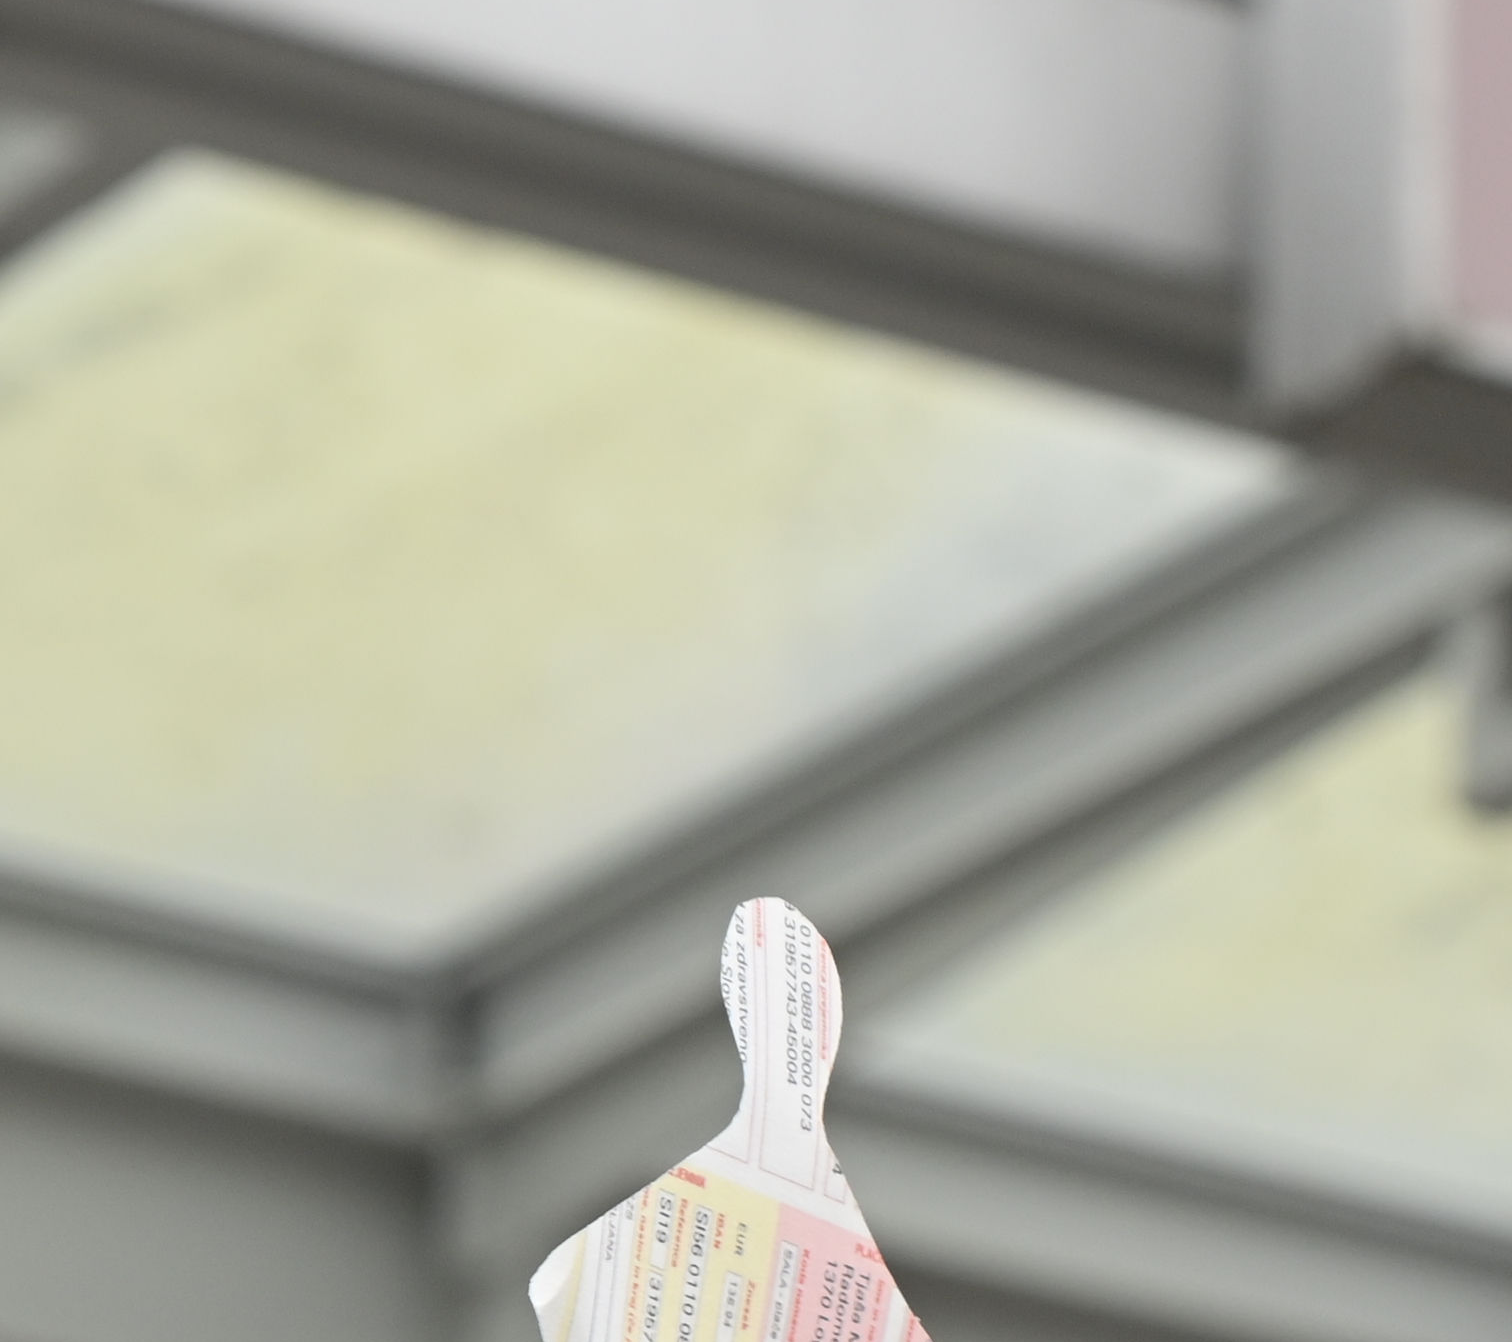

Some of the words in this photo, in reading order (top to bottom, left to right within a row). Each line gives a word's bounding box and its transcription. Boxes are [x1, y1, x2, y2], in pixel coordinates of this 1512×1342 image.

[799, 924, 811, 974] 0110
[736, 940, 747, 1063] zdravstveno
[801, 980, 811, 1030] 0888
[801, 1035, 812, 1087] 3000
[799, 1092, 811, 1132] 073
[655, 1196, 672, 1244] SI19
[690, 1210, 709, 1256] SI56
[713, 1212, 725, 1250] IBAN
[734, 1222, 747, 1256] EUR
[680, 1263, 701, 1317] 0110
[818, 1260, 838, 1309] 1370
[849, 1272, 870, 1324] Tjaša
